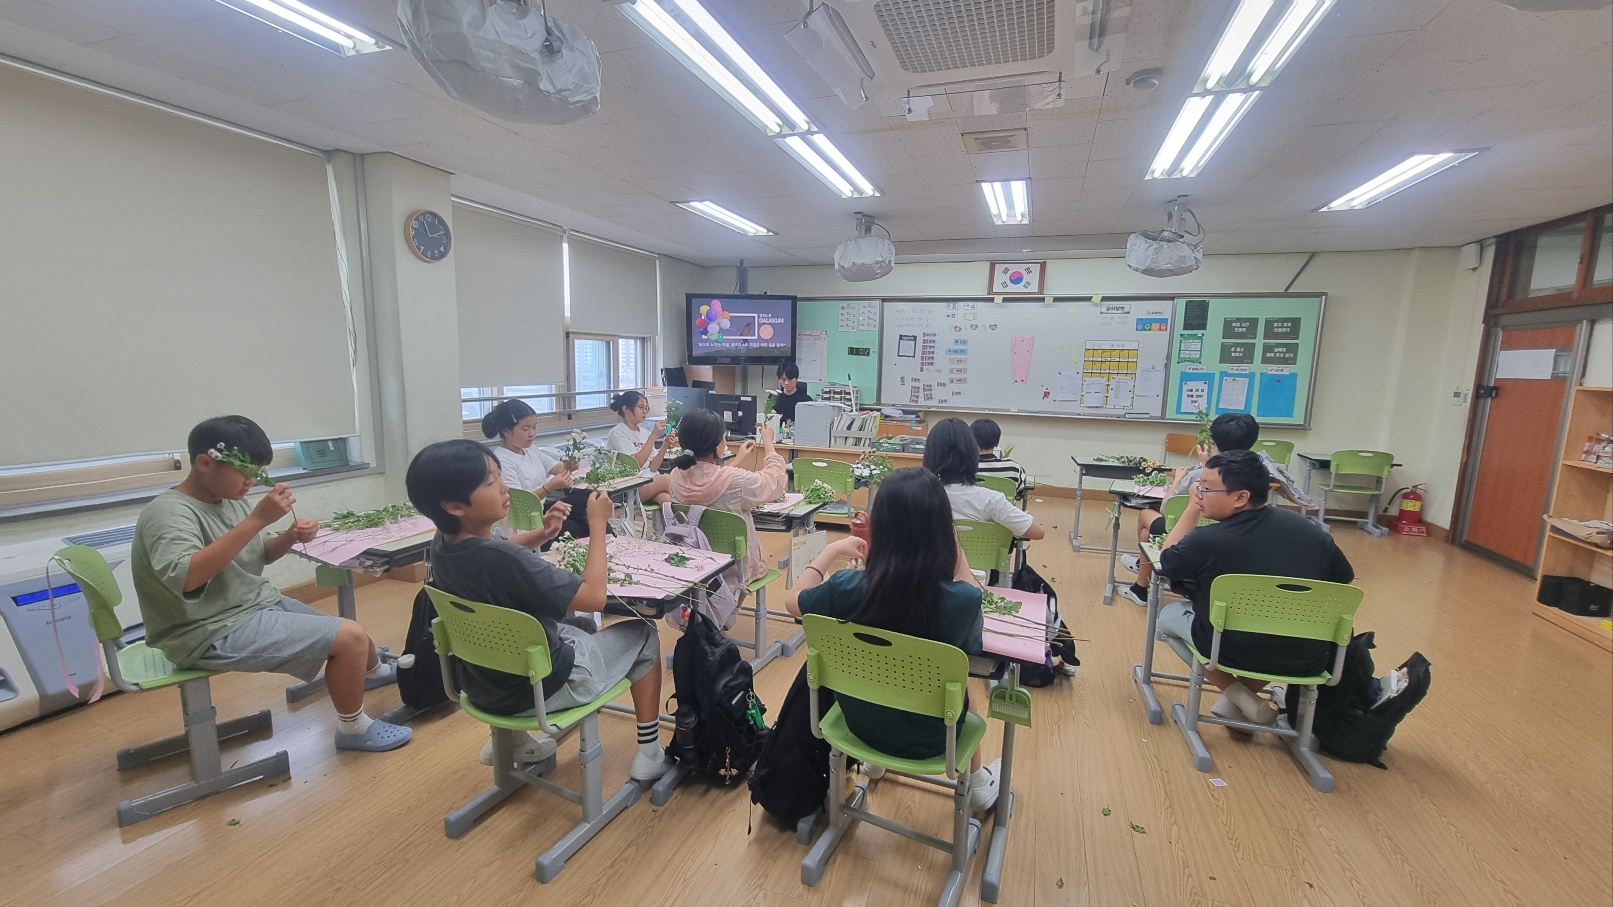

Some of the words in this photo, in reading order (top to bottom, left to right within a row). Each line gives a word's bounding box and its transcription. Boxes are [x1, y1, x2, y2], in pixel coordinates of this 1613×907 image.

[418, 214, 424, 222] 11
[425, 213, 432, 222] 12
[412, 220, 419, 228] 10
[434, 249, 439, 257] 5
